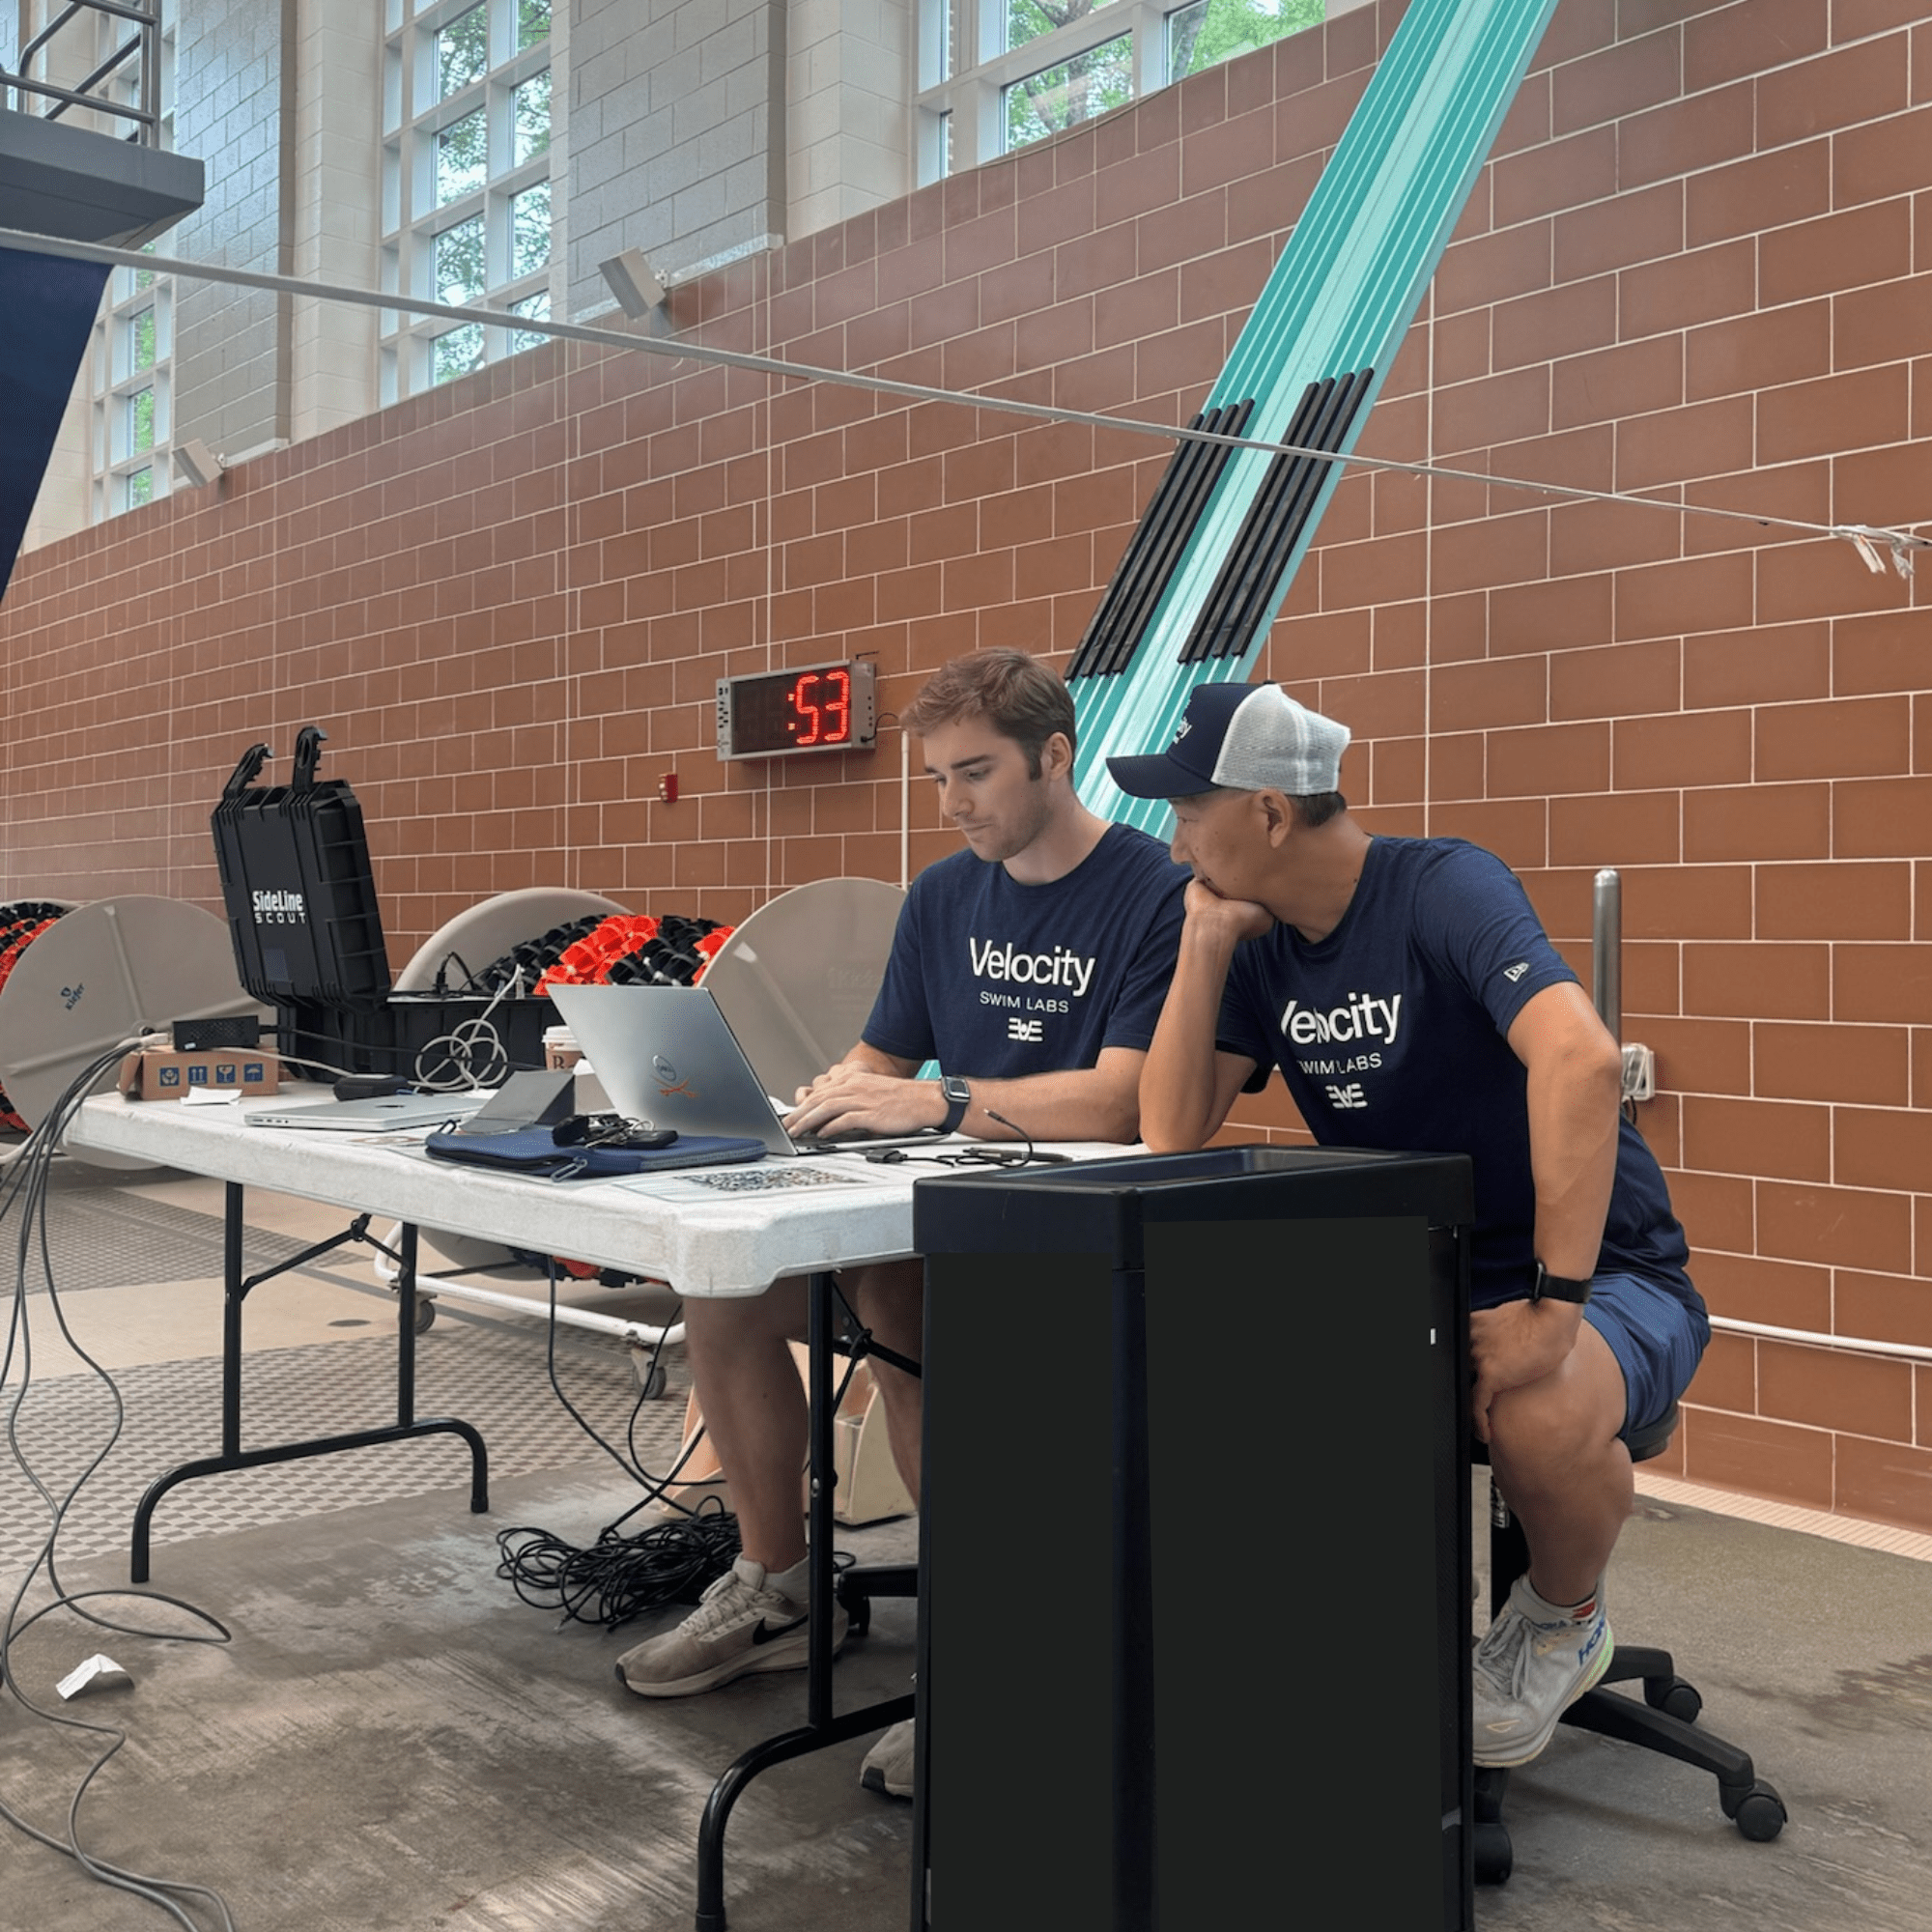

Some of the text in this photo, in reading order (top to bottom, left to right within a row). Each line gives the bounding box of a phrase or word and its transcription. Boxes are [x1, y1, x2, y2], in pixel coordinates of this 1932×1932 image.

[252, 890, 303, 912] SideLine
[254, 912, 306, 924] SCOUT
[969, 937, 1096, 997] Velocity
[980, 991, 1069, 1013] SWIM LABS
[1296, 1060, 1335, 1075] WIM
